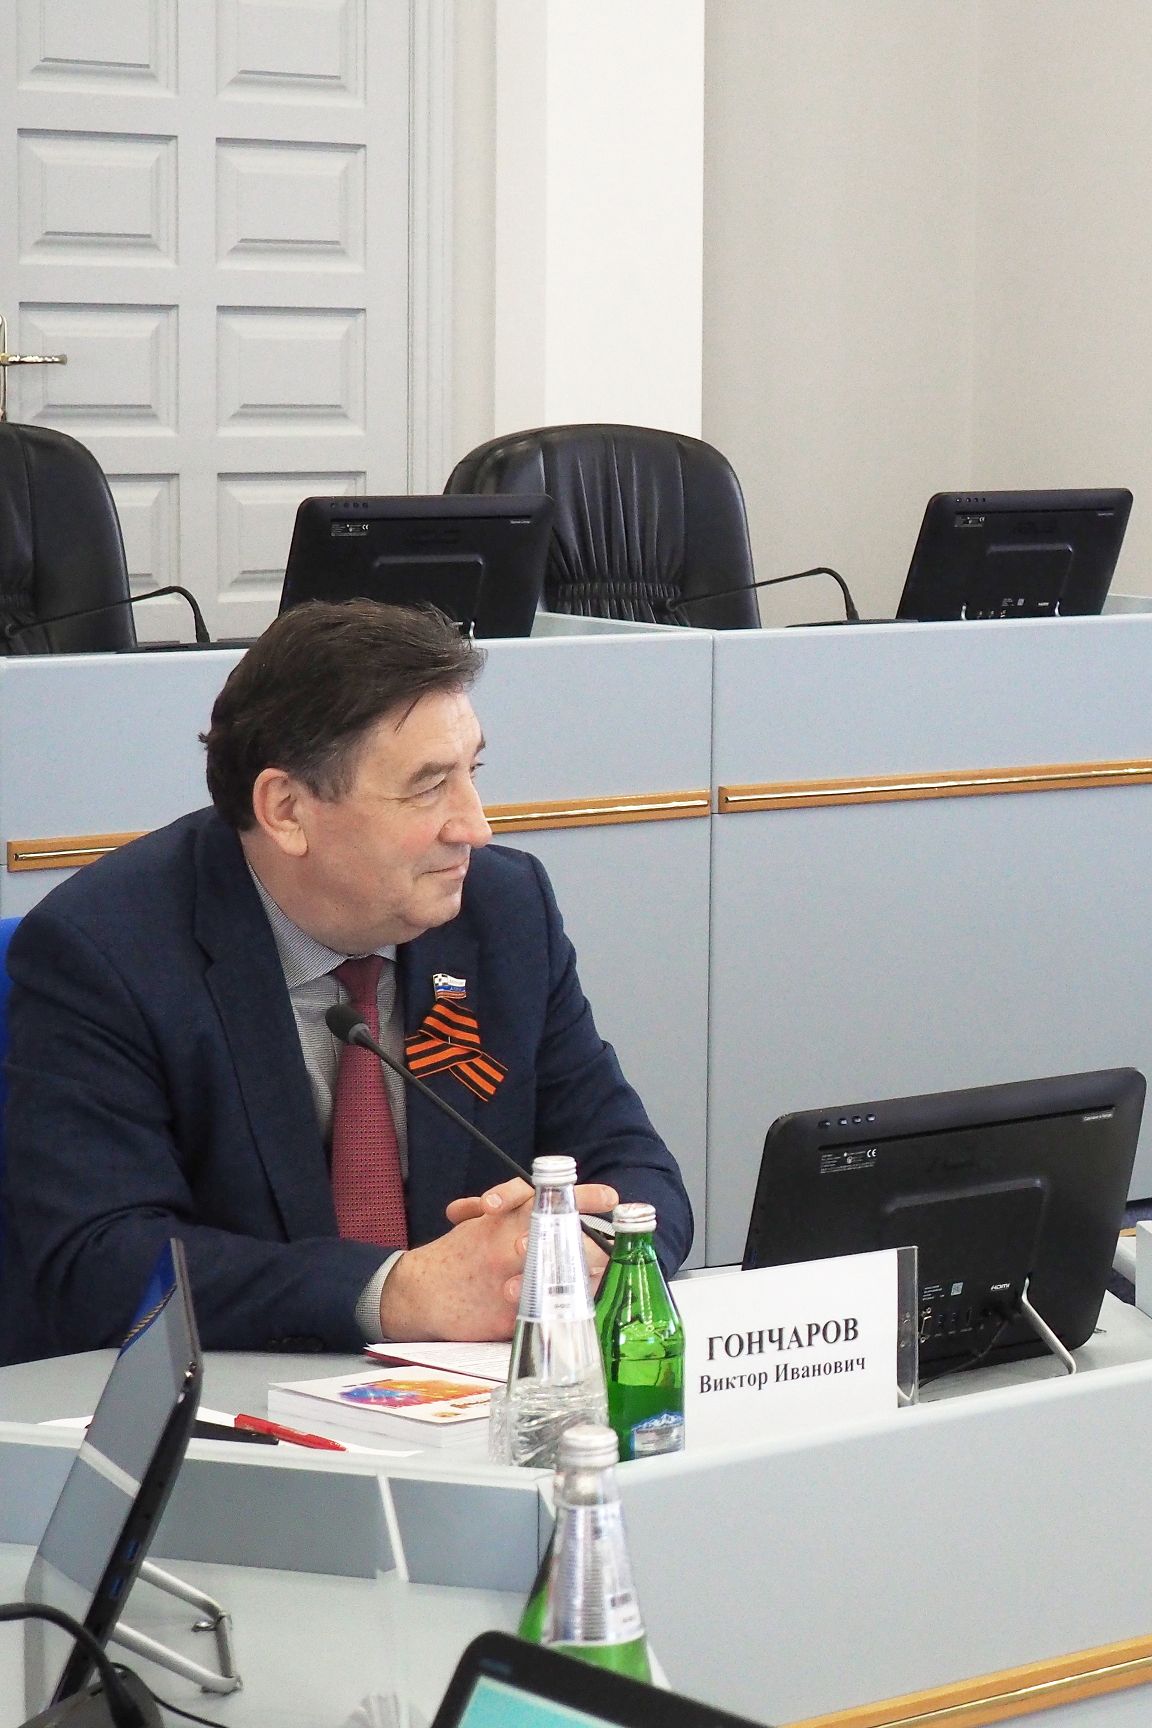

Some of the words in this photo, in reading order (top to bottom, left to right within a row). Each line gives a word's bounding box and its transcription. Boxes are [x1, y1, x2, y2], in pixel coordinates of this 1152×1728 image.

[706, 1317, 859, 1361] ГОНЧАРОВ
[699, 1370, 768, 1394] Виктор
[775, 1357, 866, 1383] Иванович
